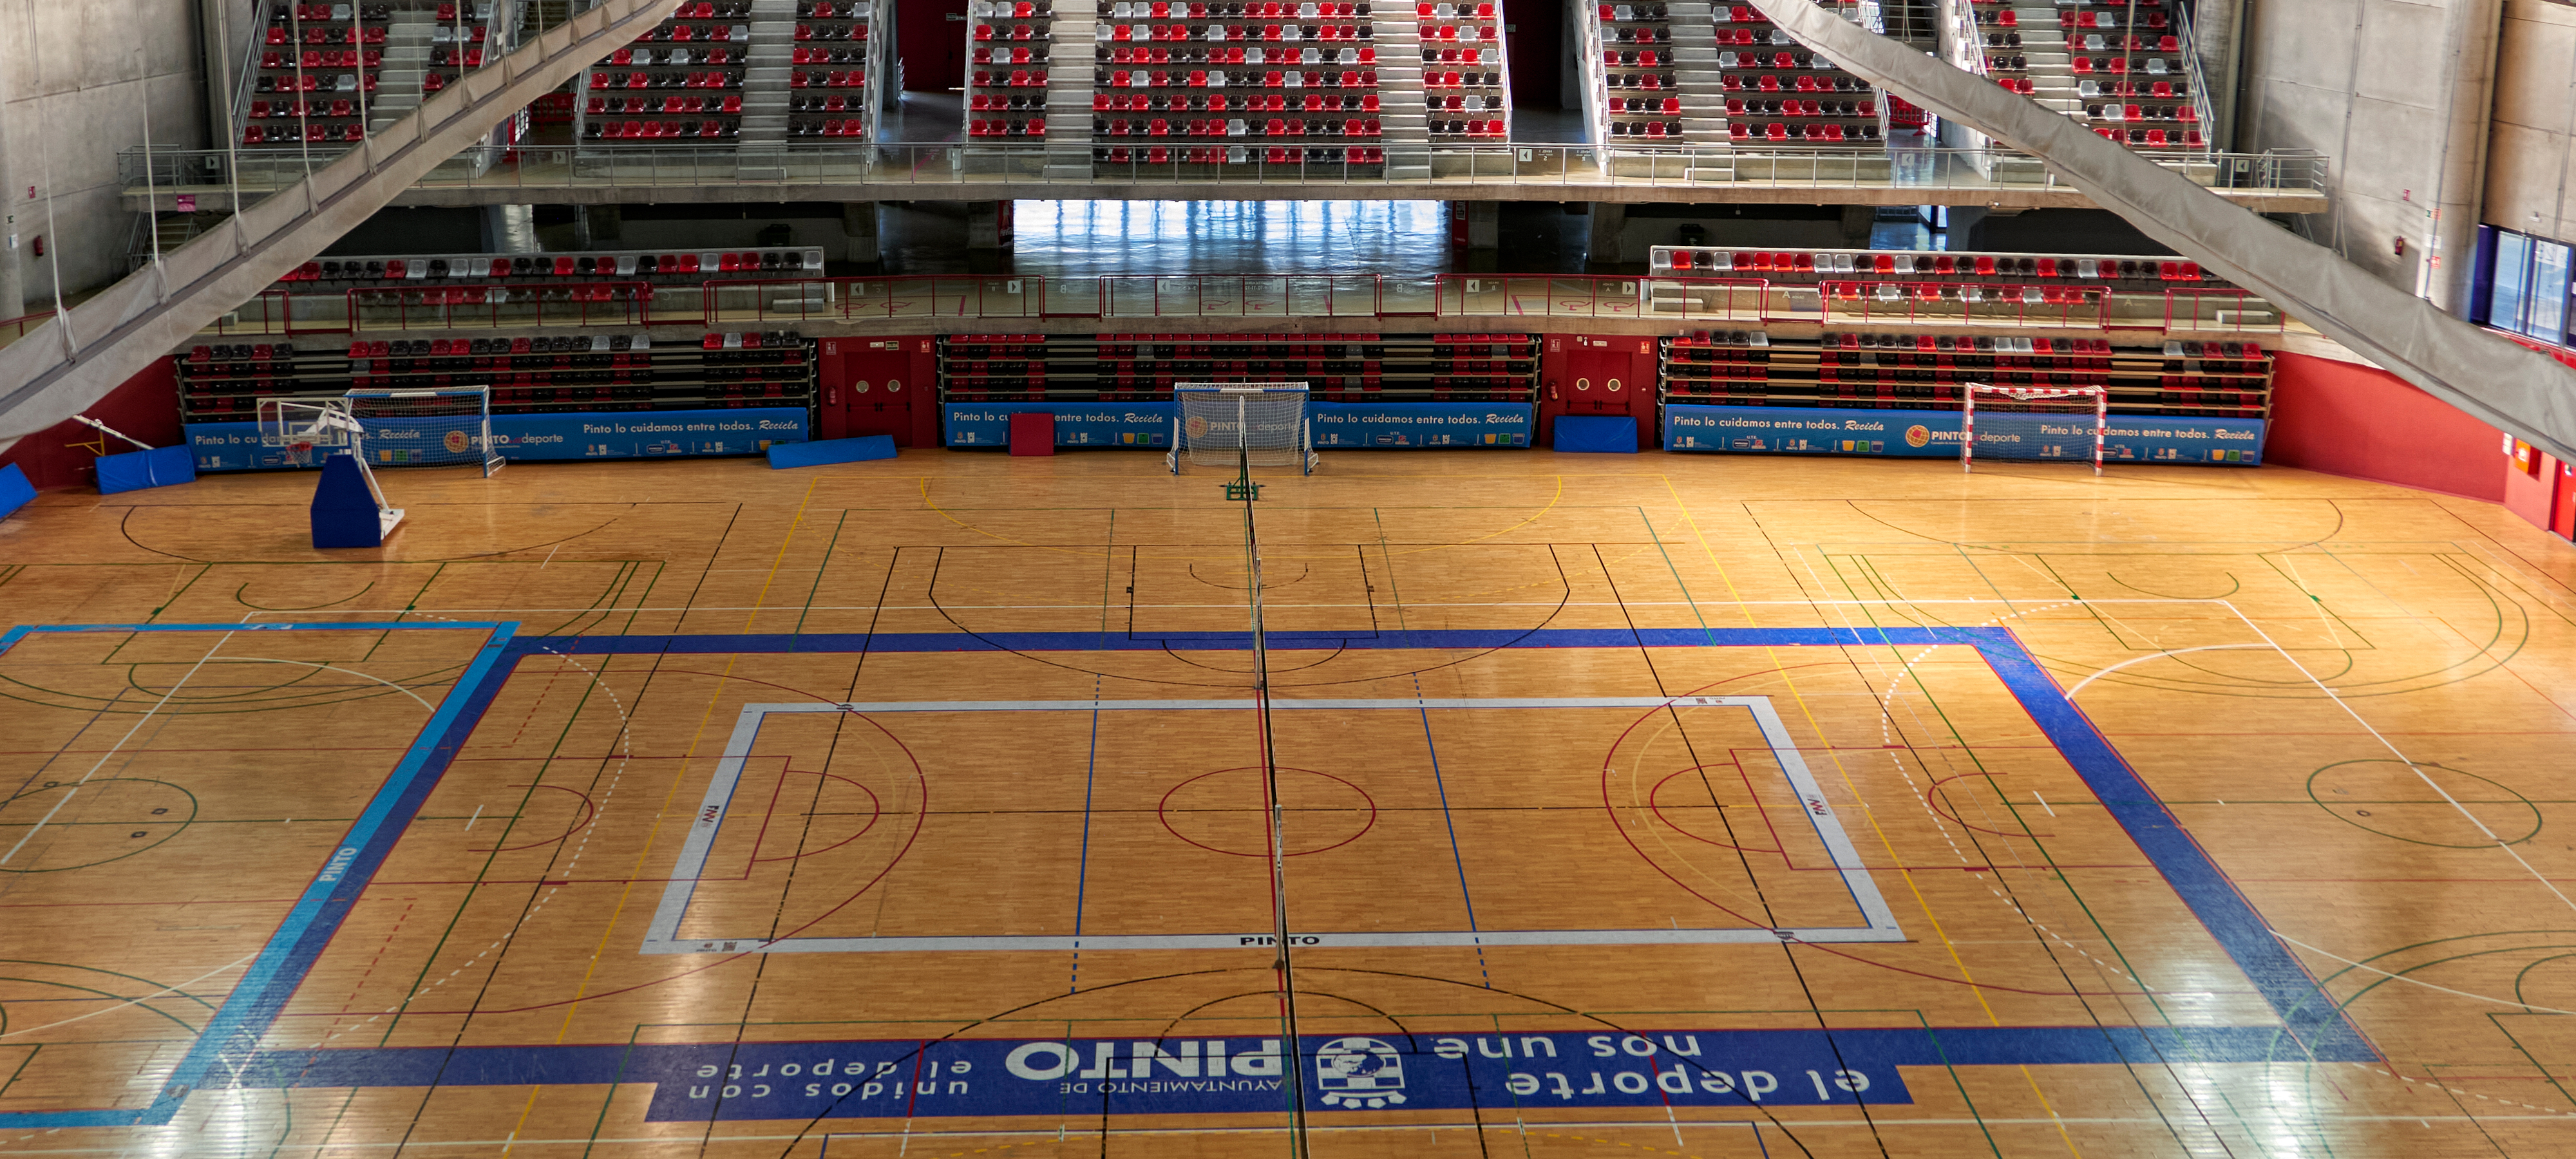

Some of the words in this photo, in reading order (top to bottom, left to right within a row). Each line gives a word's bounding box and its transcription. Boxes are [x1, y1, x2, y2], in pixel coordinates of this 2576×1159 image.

[954, 412, 980, 422] Pinto
[985, 411, 995, 421] lo
[1054, 413, 1082, 422] entre
[1086, 412, 1119, 422] todos.
[1124, 412, 1163, 424] Recicla
[1318, 413, 1344, 423] Pinto
[1348, 413, 1358, 423] lo
[1362, 413, 1413, 424] cuidamos
[1416, 415, 1444, 424] entre
[1448, 414, 1481, 424] todos.
[1485, 413, 1524, 424] Recicla
[1674, 416, 1701, 426] Pinto
[1705, 417, 1715, 426] lo
[1719, 417, 1771, 428] cuidamos
[1774, 420, 1803, 429] entre
[1806, 419, 1840, 430] todos.
[1845, 420, 1884, 431] Recicla
[583, 424, 612, 433] Pinto
[616, 423, 626, 433] lo
[630, 422, 683, 433] cuidamos
[687, 422, 715, 431] entre
[719, 420, 754, 431] todos.
[759, 420, 799, 431] Recicla
[1258, 420, 1298, 433] deporte
[2041, 424, 2069, 435] Pinto
[2072, 425, 2083, 435] lo
[2087, 426, 2139, 437] cudamos
[2143, 429, 2172, 438] entre
[2175, 428, 2210, 438] todos.
[2214, 428, 2255, 440] Recicla
[195, 435, 225, 445] Pinto
[229, 433, 240, 444] lo
[522, 433, 564, 446] deporte
[1932, 431, 1968, 440] PINTO
[1980, 431, 2021, 444] deporte
[318, 847, 357, 881] PINTO
[1240, 936, 1320, 945] PINTO
[1434, 1037, 1557, 1059] une
[1591, 1035, 1702, 1058] nos
[1005, 1039, 1283, 1080] PINTO
[697, 1059, 898, 1080] deporte
[930, 1060, 972, 1079] el
[1060, 1082, 1087, 1093] DE
[1099, 1080, 1282, 1094] AYUNTAMIENTO
[1506, 1063, 1779, 1102] deporte
[1806, 1069, 1870, 1101] el
[689, 1083, 771, 1099] con
[805, 1082, 969, 1100] unidos
